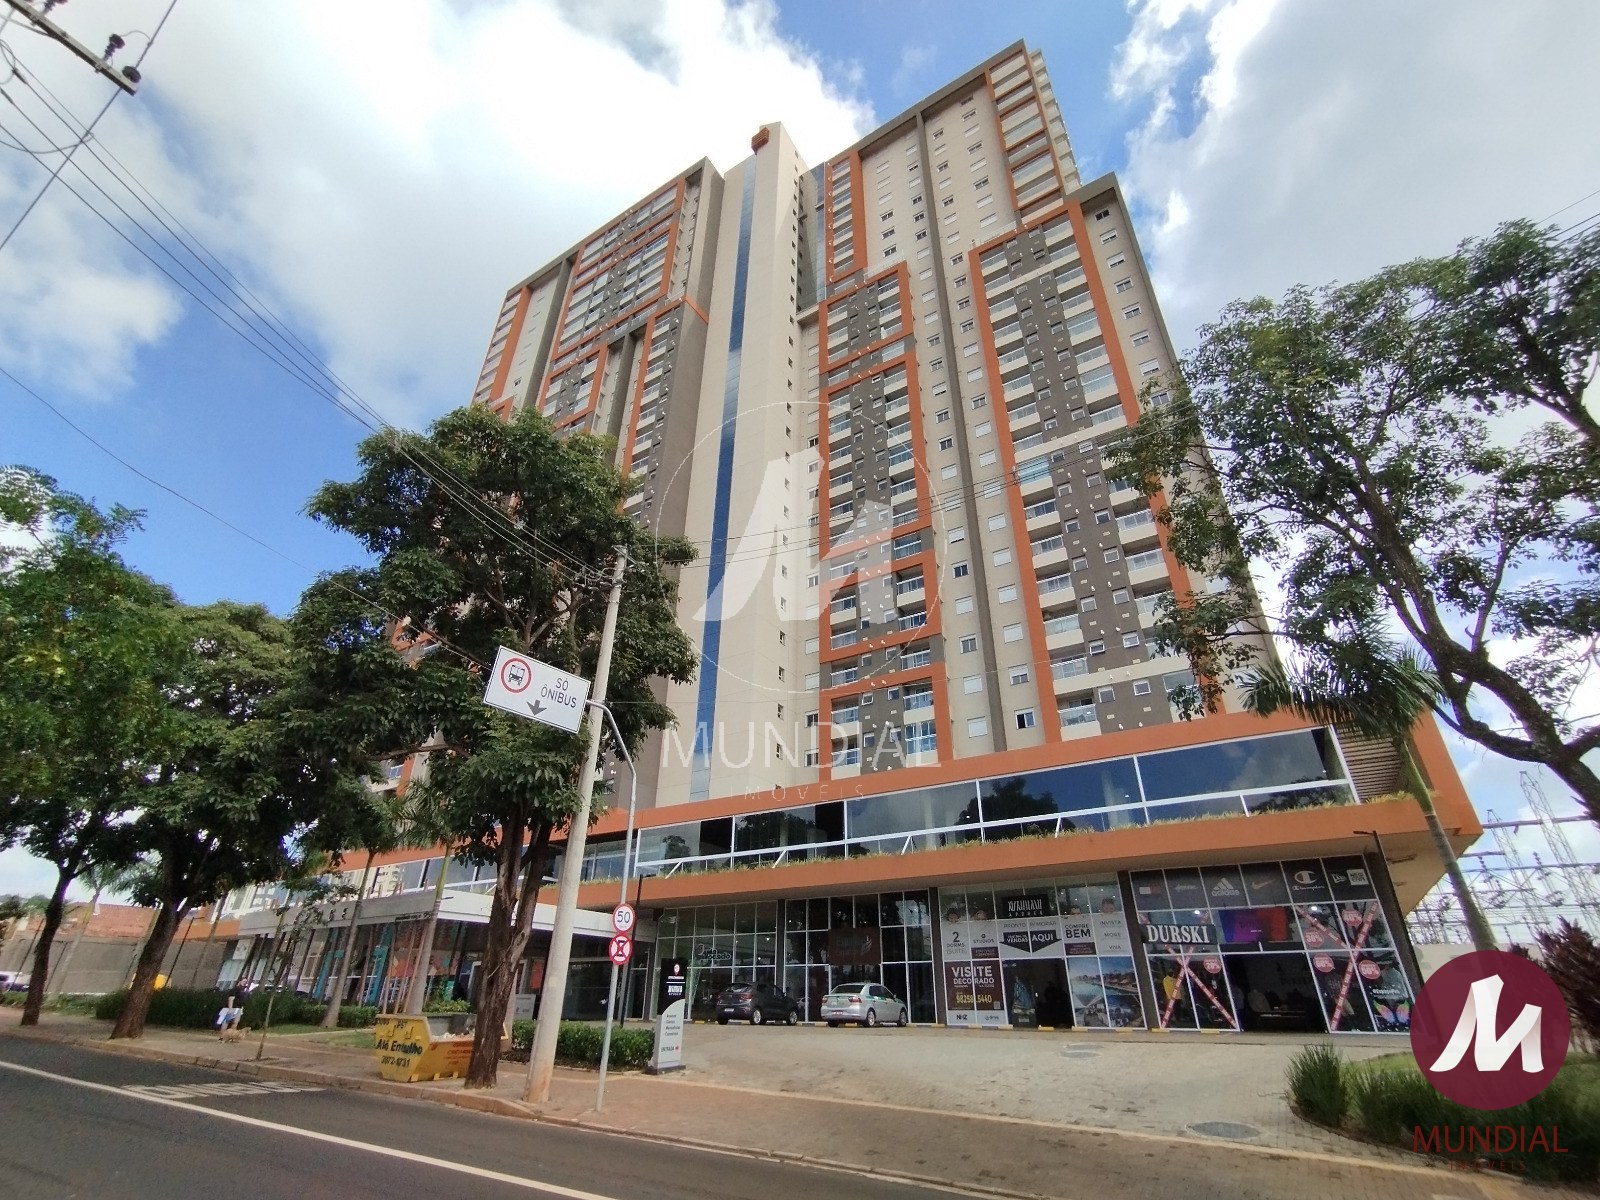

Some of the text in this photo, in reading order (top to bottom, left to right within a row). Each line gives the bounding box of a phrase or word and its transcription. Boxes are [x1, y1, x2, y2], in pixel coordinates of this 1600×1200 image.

[555, 677, 569, 691] SÓ
[541, 684, 577, 708] ÔNIBUS
[1211, 888, 1240, 897] adidas
[617, 911, 630, 923] 50
[952, 931, 960, 943] 2
[1031, 933, 1054, 942] AQUI
[1065, 929, 1091, 939] BEM
[1146, 924, 1211, 944] DURSKI
[951, 966, 992, 978] VISITE
